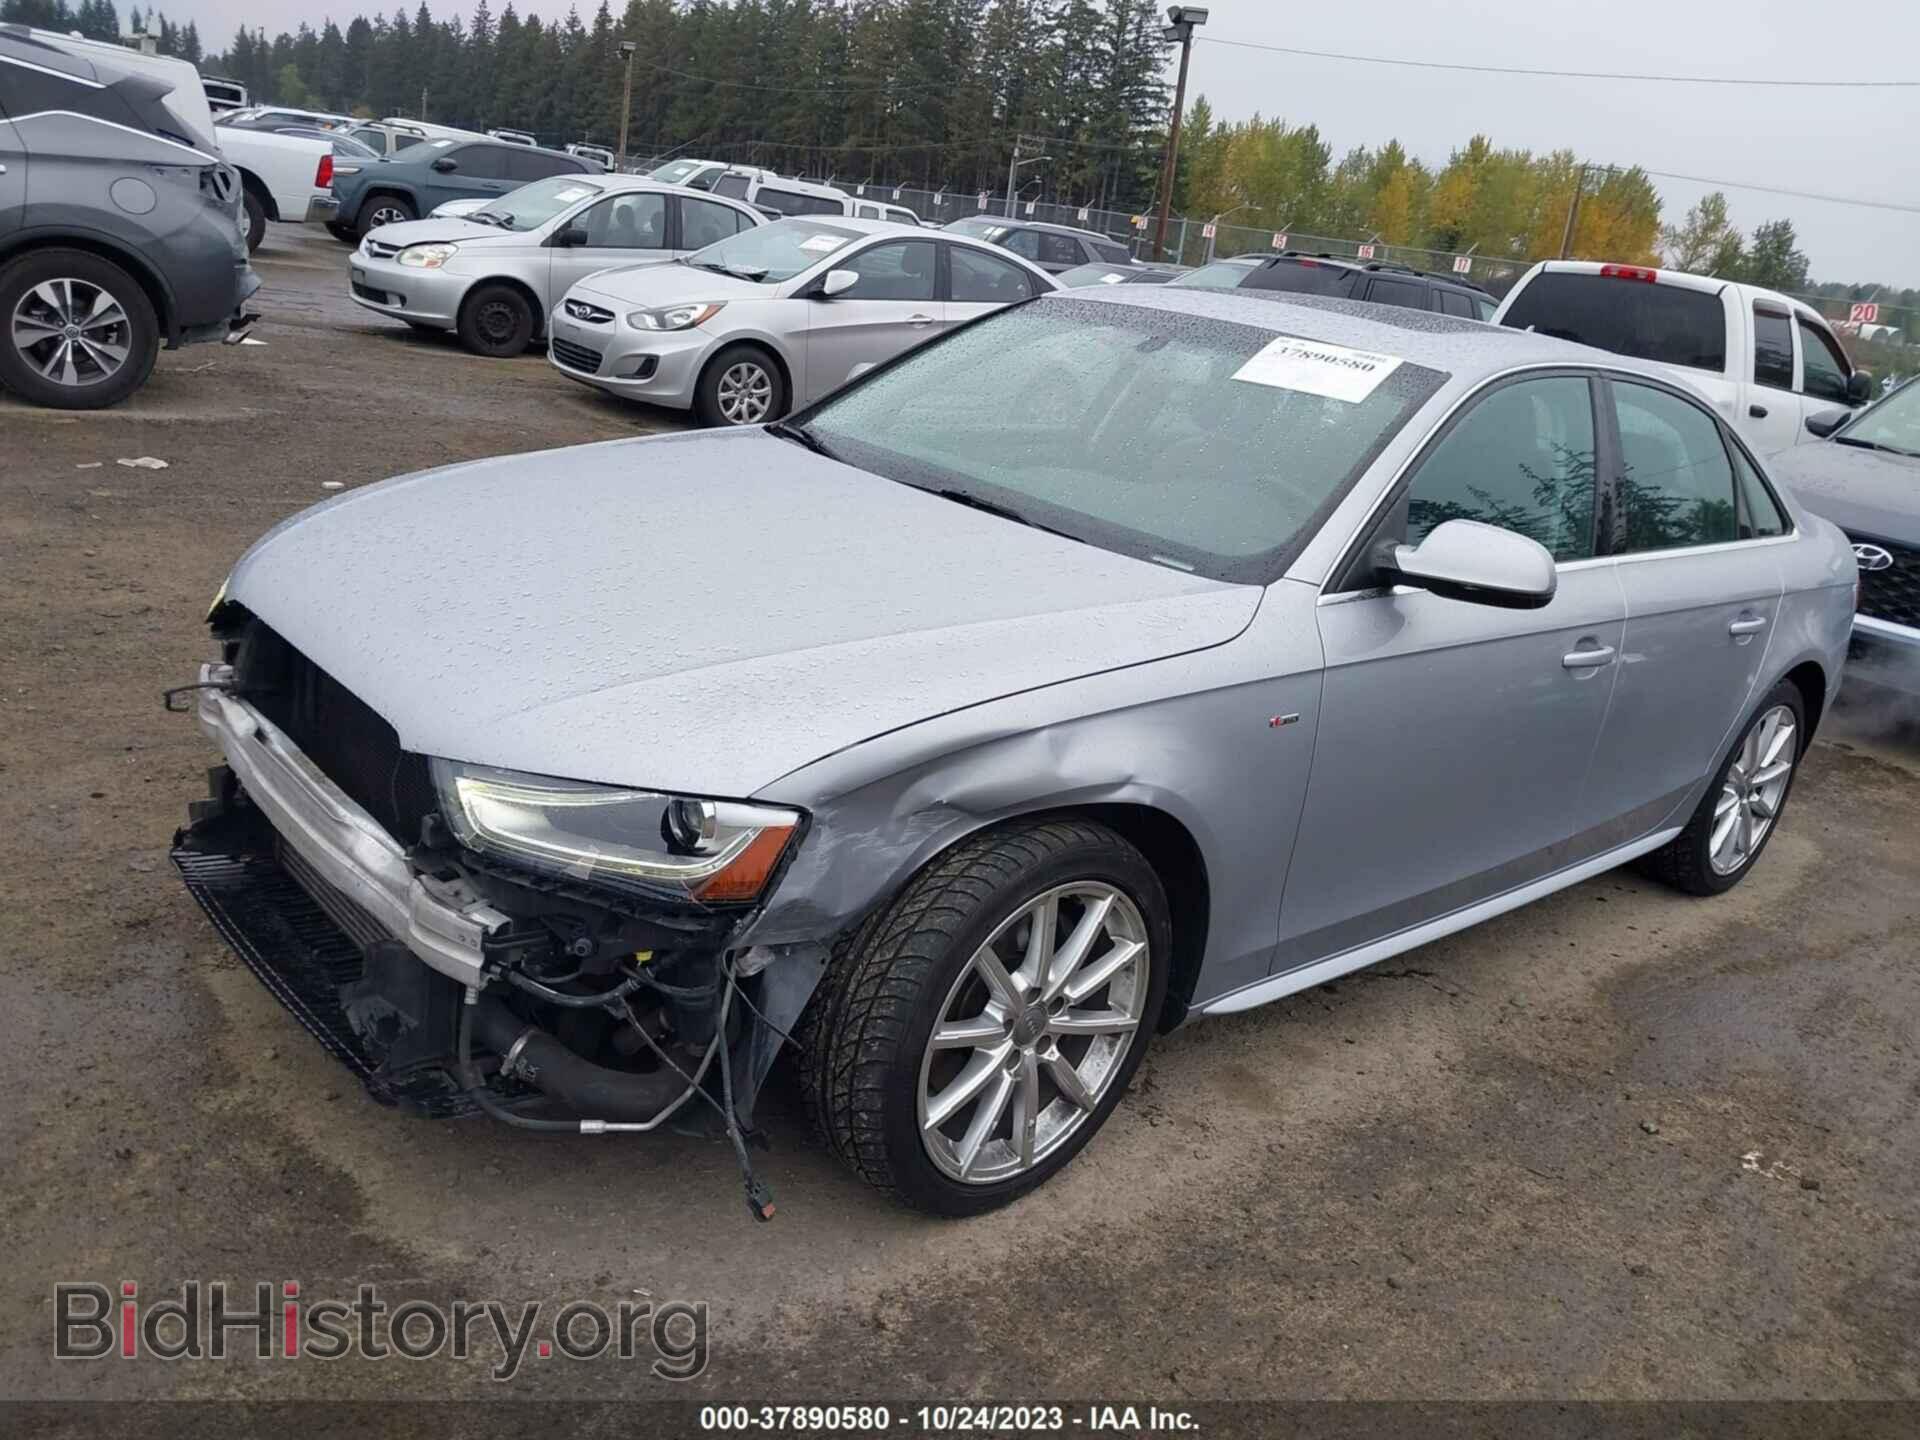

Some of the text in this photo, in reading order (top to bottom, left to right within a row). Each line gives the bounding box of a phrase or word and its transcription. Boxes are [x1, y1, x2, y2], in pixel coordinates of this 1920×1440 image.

[1275, 235, 1285, 247] 15
[1361, 246, 1371, 257] 16
[1457, 258, 1468, 271] 17
[1852, 304, 1876, 321] 20
